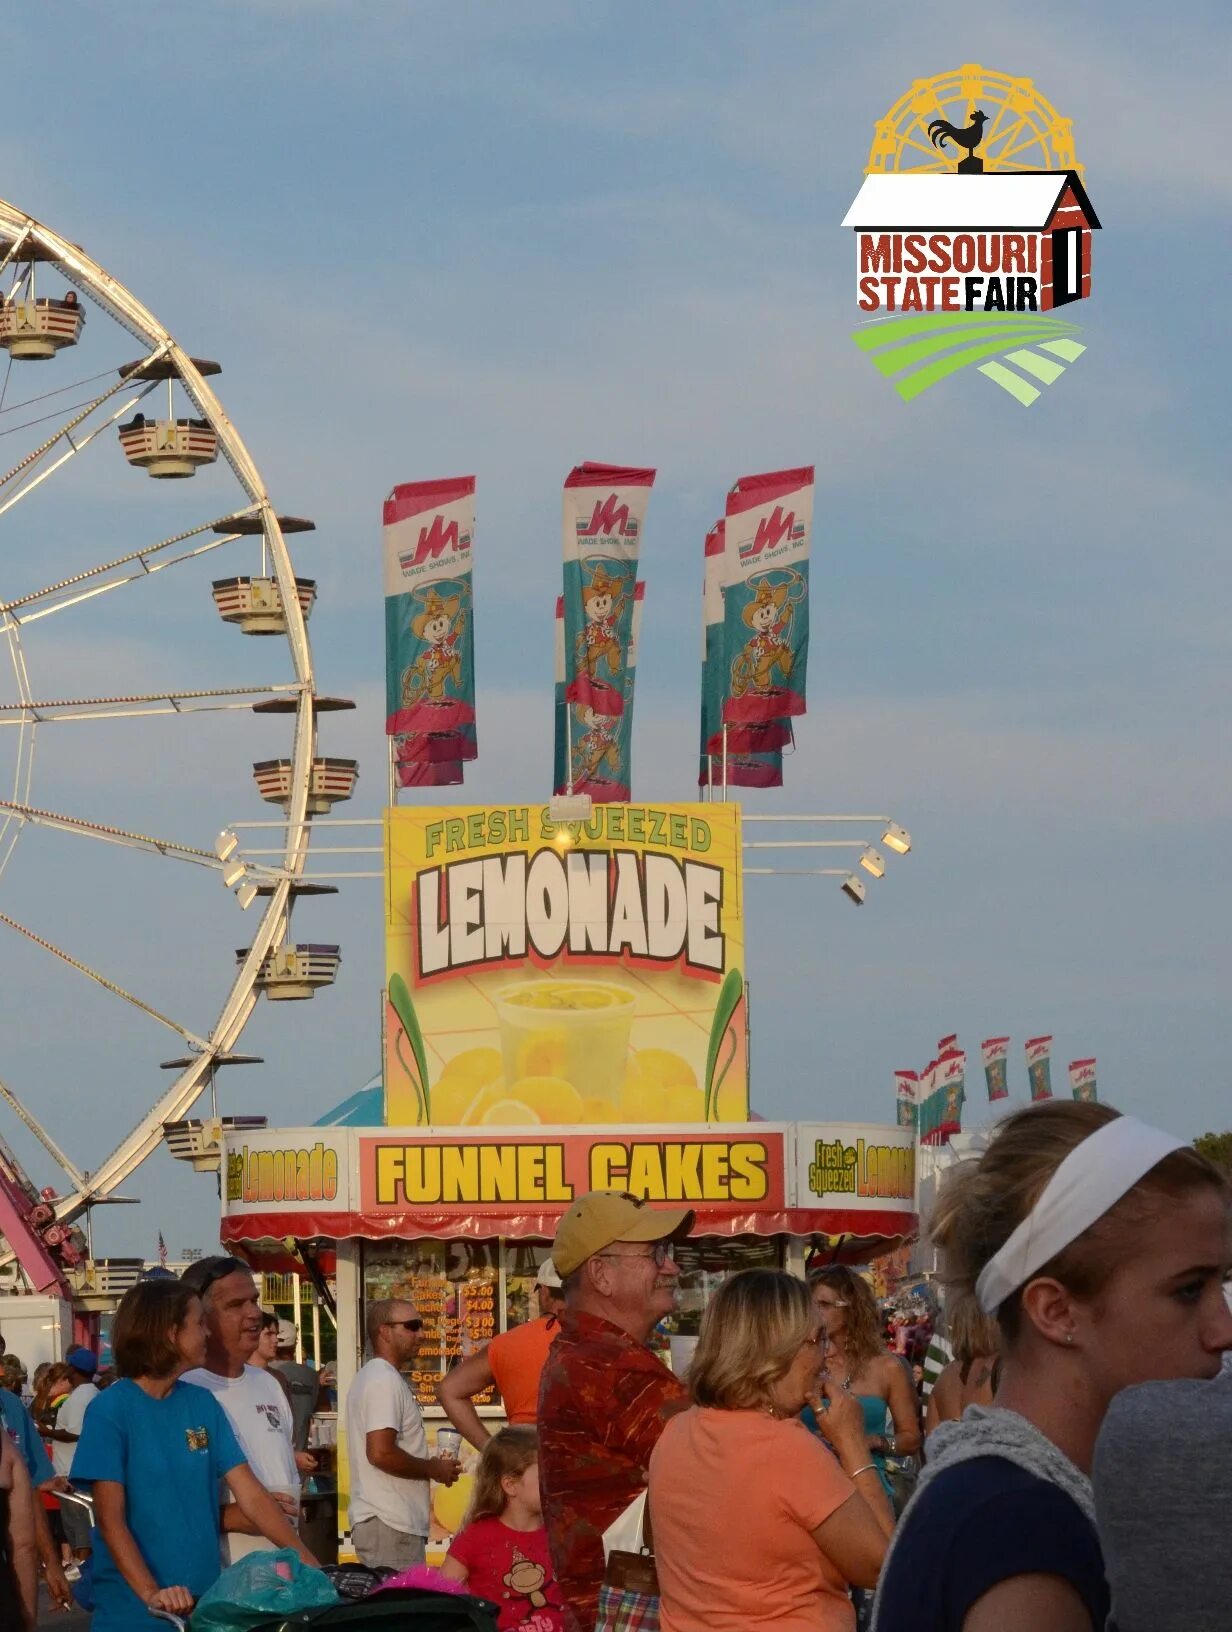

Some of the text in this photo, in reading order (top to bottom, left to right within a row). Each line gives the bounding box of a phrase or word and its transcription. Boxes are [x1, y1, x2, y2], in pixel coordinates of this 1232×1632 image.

[402, 567, 427, 577] WADE
[740, 556, 761, 568] WADE
[425, 809, 529, 858] FRESH
[416, 847, 725, 979] LEMONADE
[815, 1139, 844, 1168] Fresh
[243, 1142, 338, 1203] Lemonade
[375, 1142, 768, 1204] FUNNEL CAKES
[809, 1162, 856, 1198] Squeezed
[463, 1285, 494, 1297] $5.00
[466, 1300, 494, 1311] $4.00
